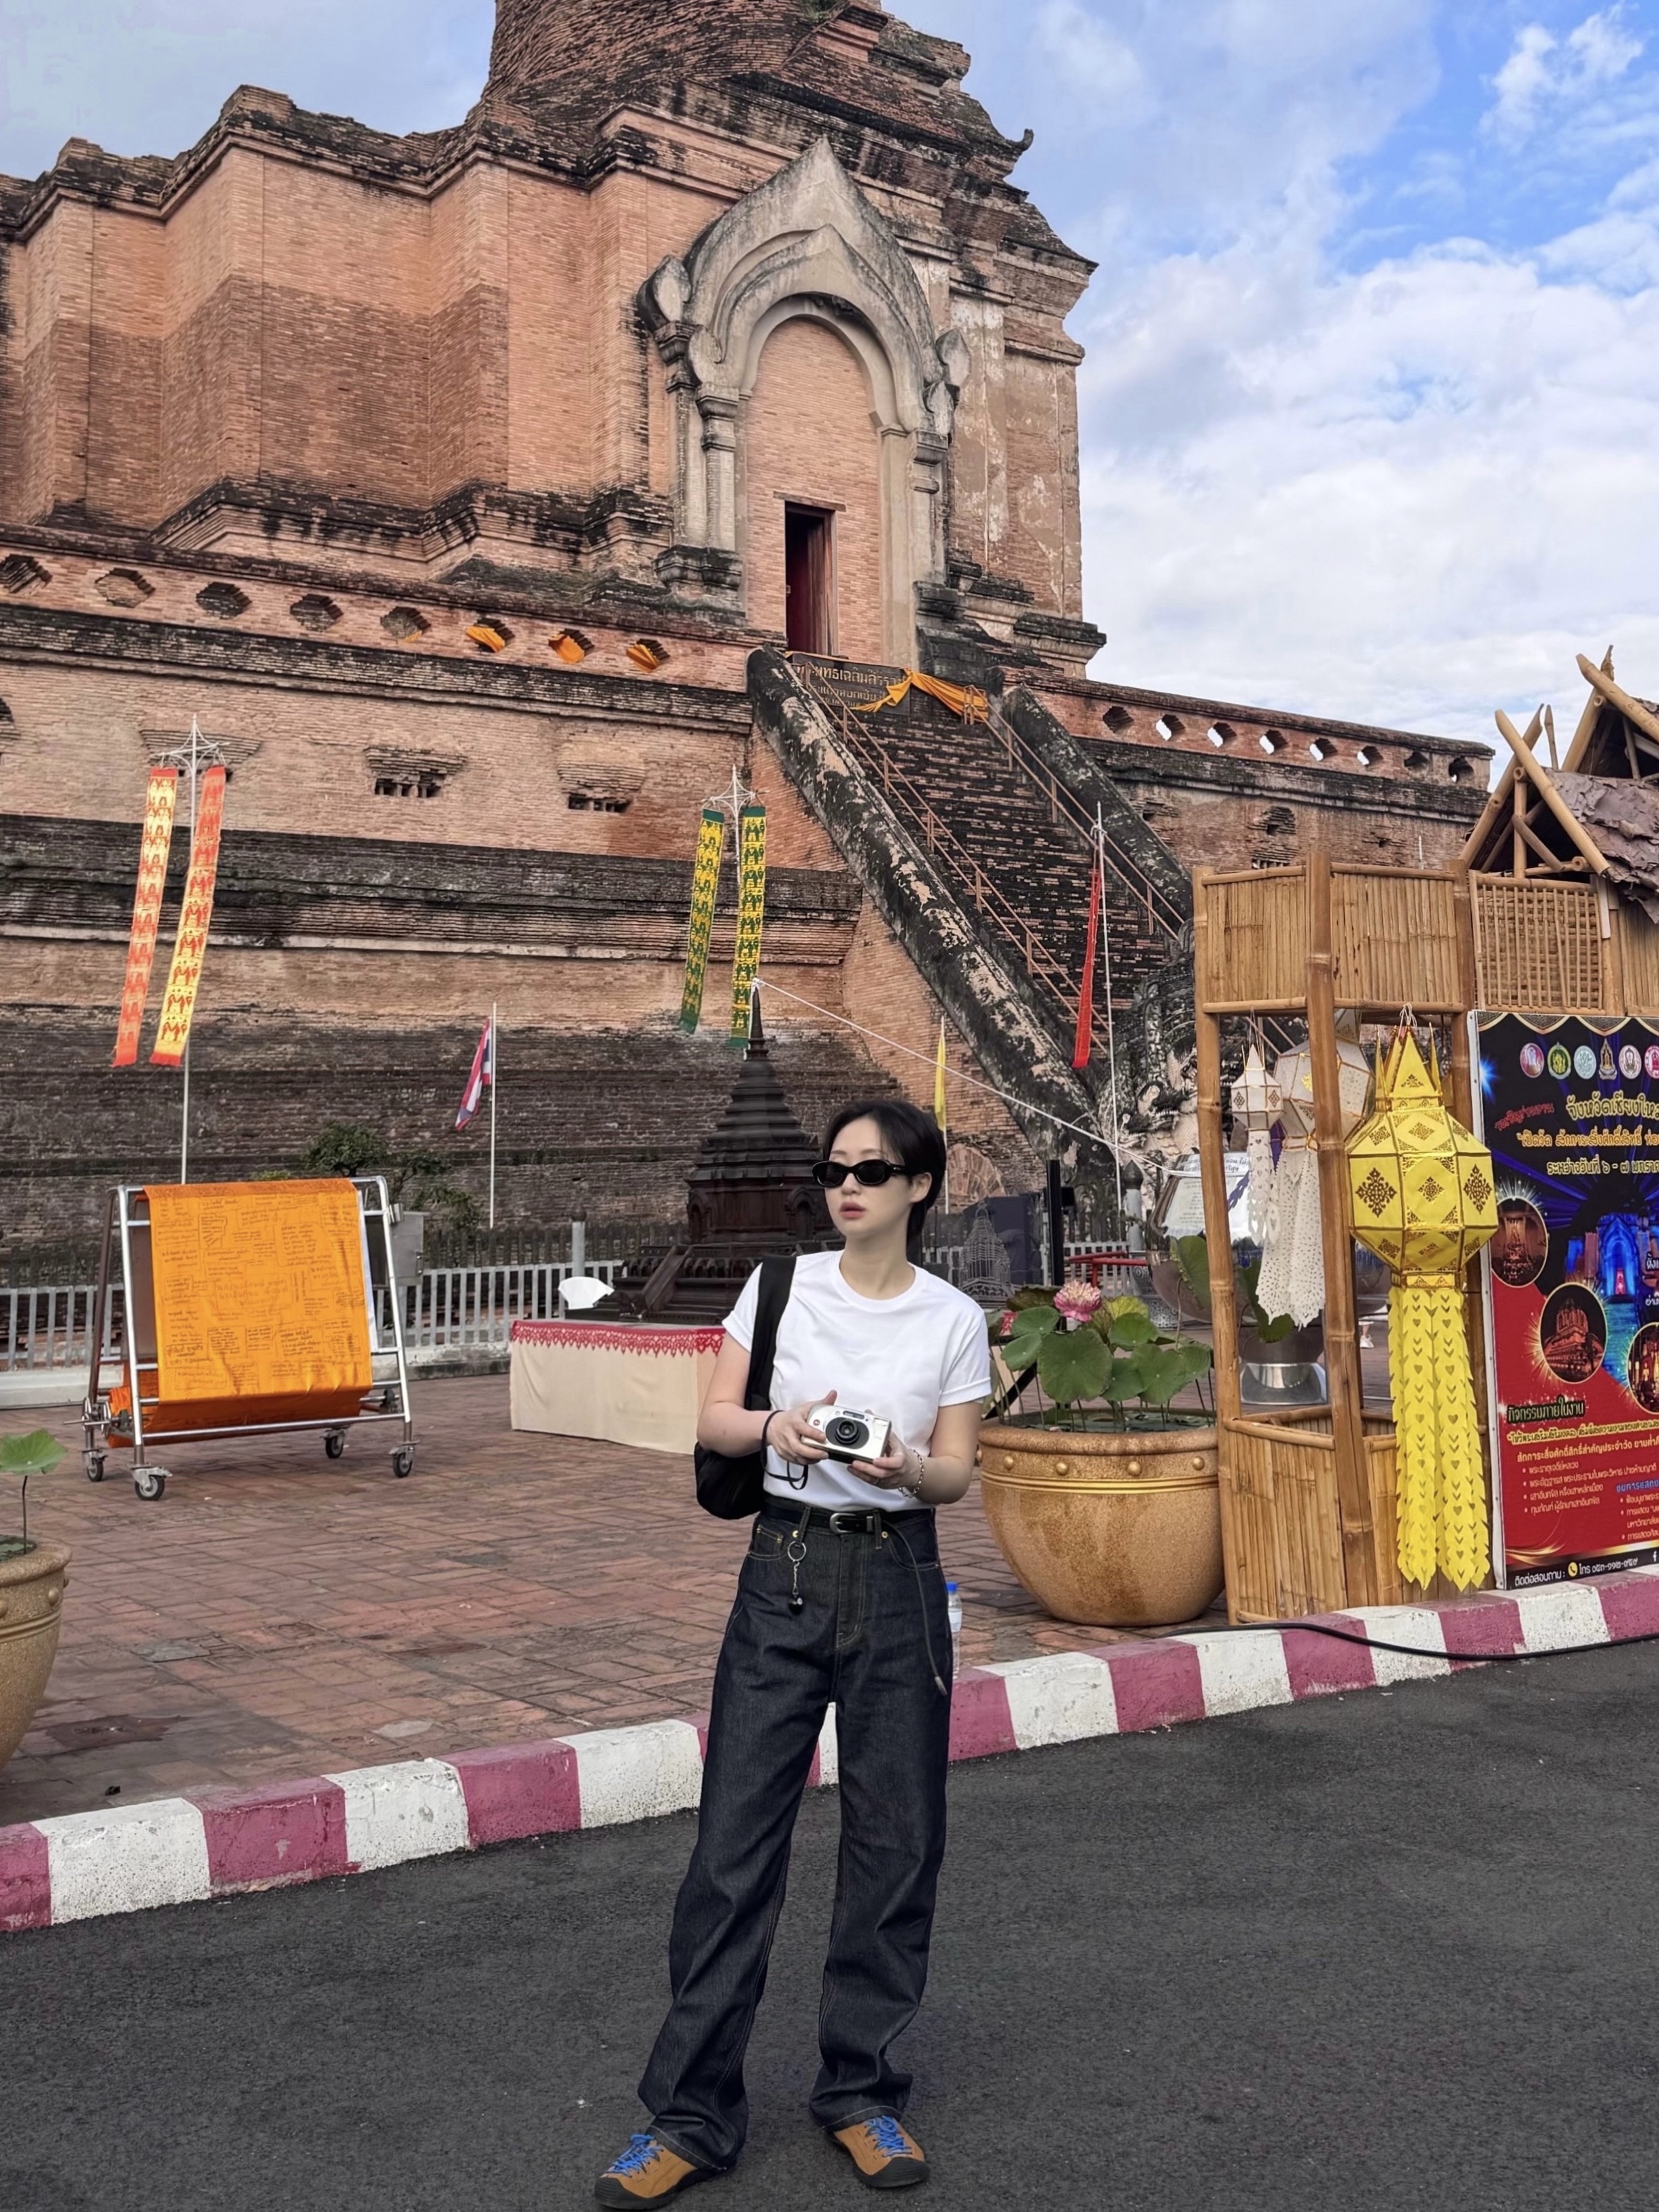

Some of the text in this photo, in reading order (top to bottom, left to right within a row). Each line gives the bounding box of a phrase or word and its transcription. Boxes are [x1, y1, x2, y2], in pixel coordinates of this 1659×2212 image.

[1508, 1397, 1584, 1422] กิจกรรมภายในงาน
